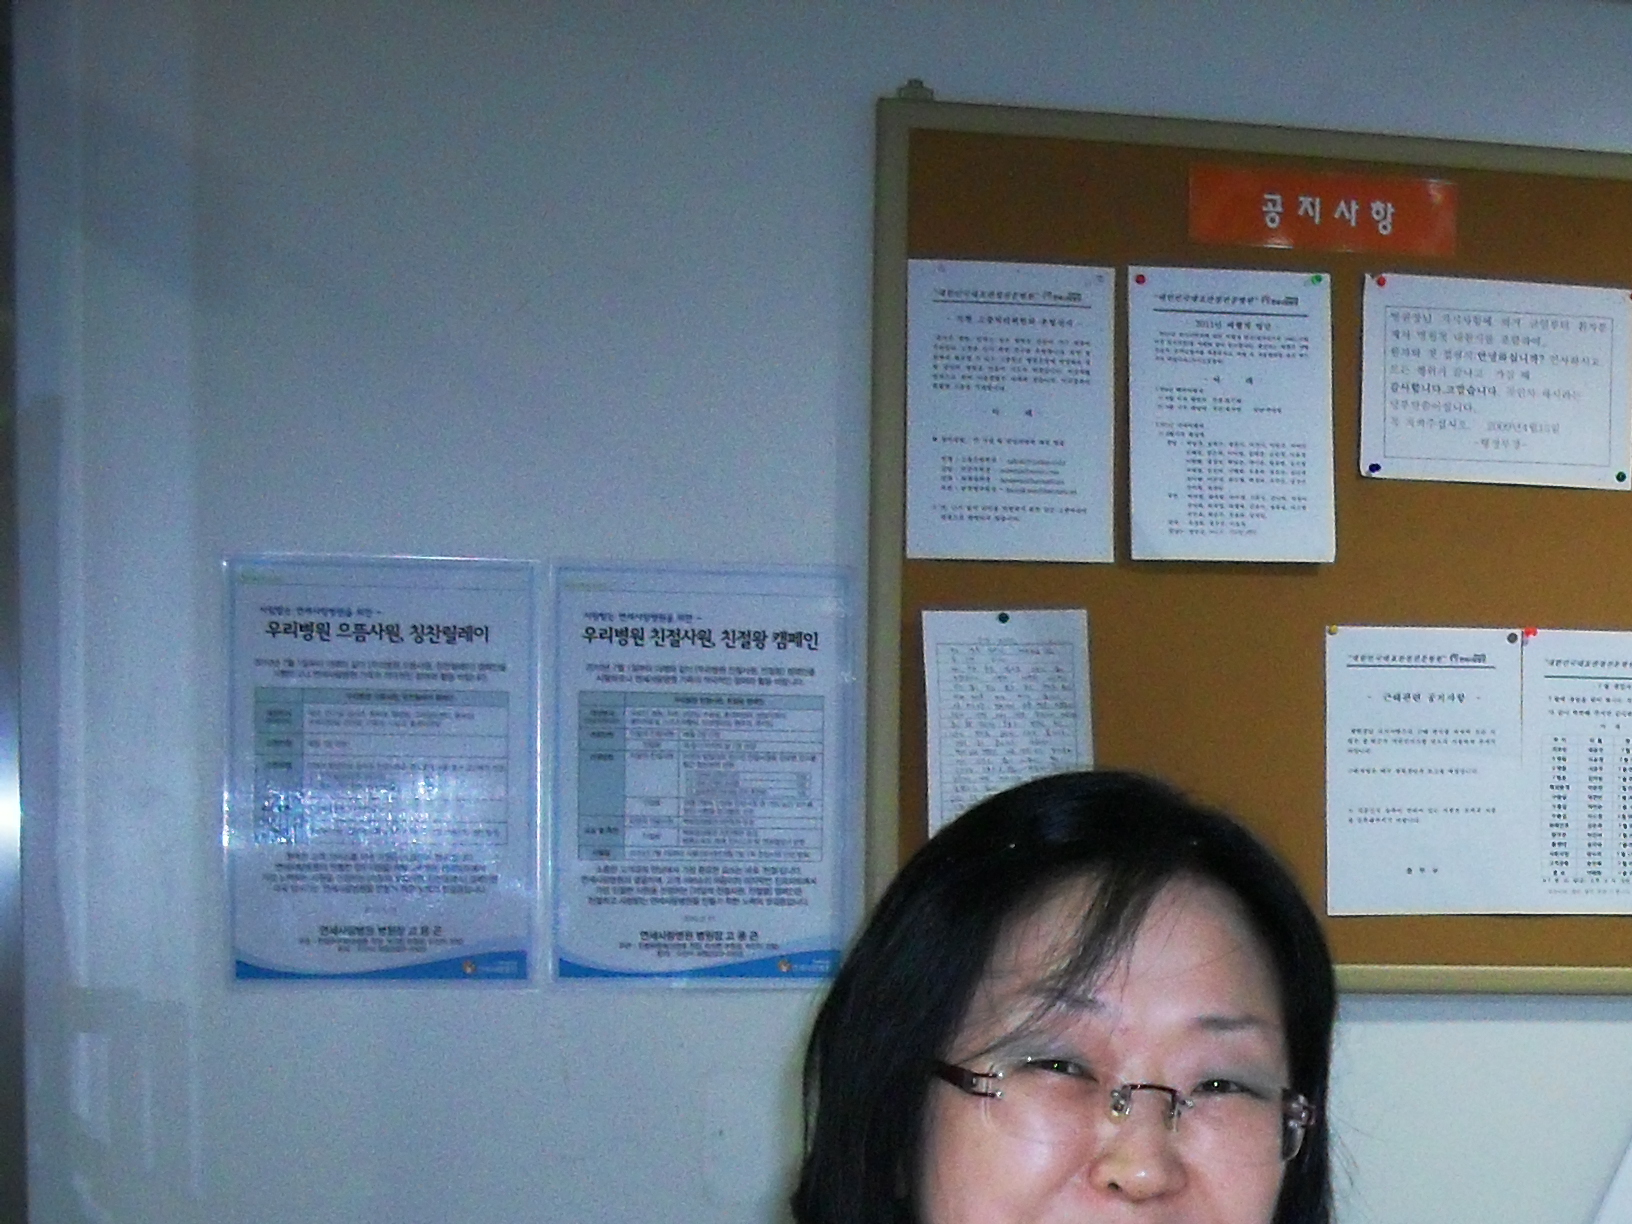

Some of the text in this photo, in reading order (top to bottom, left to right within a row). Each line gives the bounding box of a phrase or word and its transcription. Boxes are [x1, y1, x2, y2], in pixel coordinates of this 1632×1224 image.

[1262, 193, 1395, 236] 공지사항
[266, 621, 489, 643] 우리병원 으뜸사원, 칭찬릴레이
[582, 626, 819, 651] 우리병원 친절사원, 친절왕 캠페인
